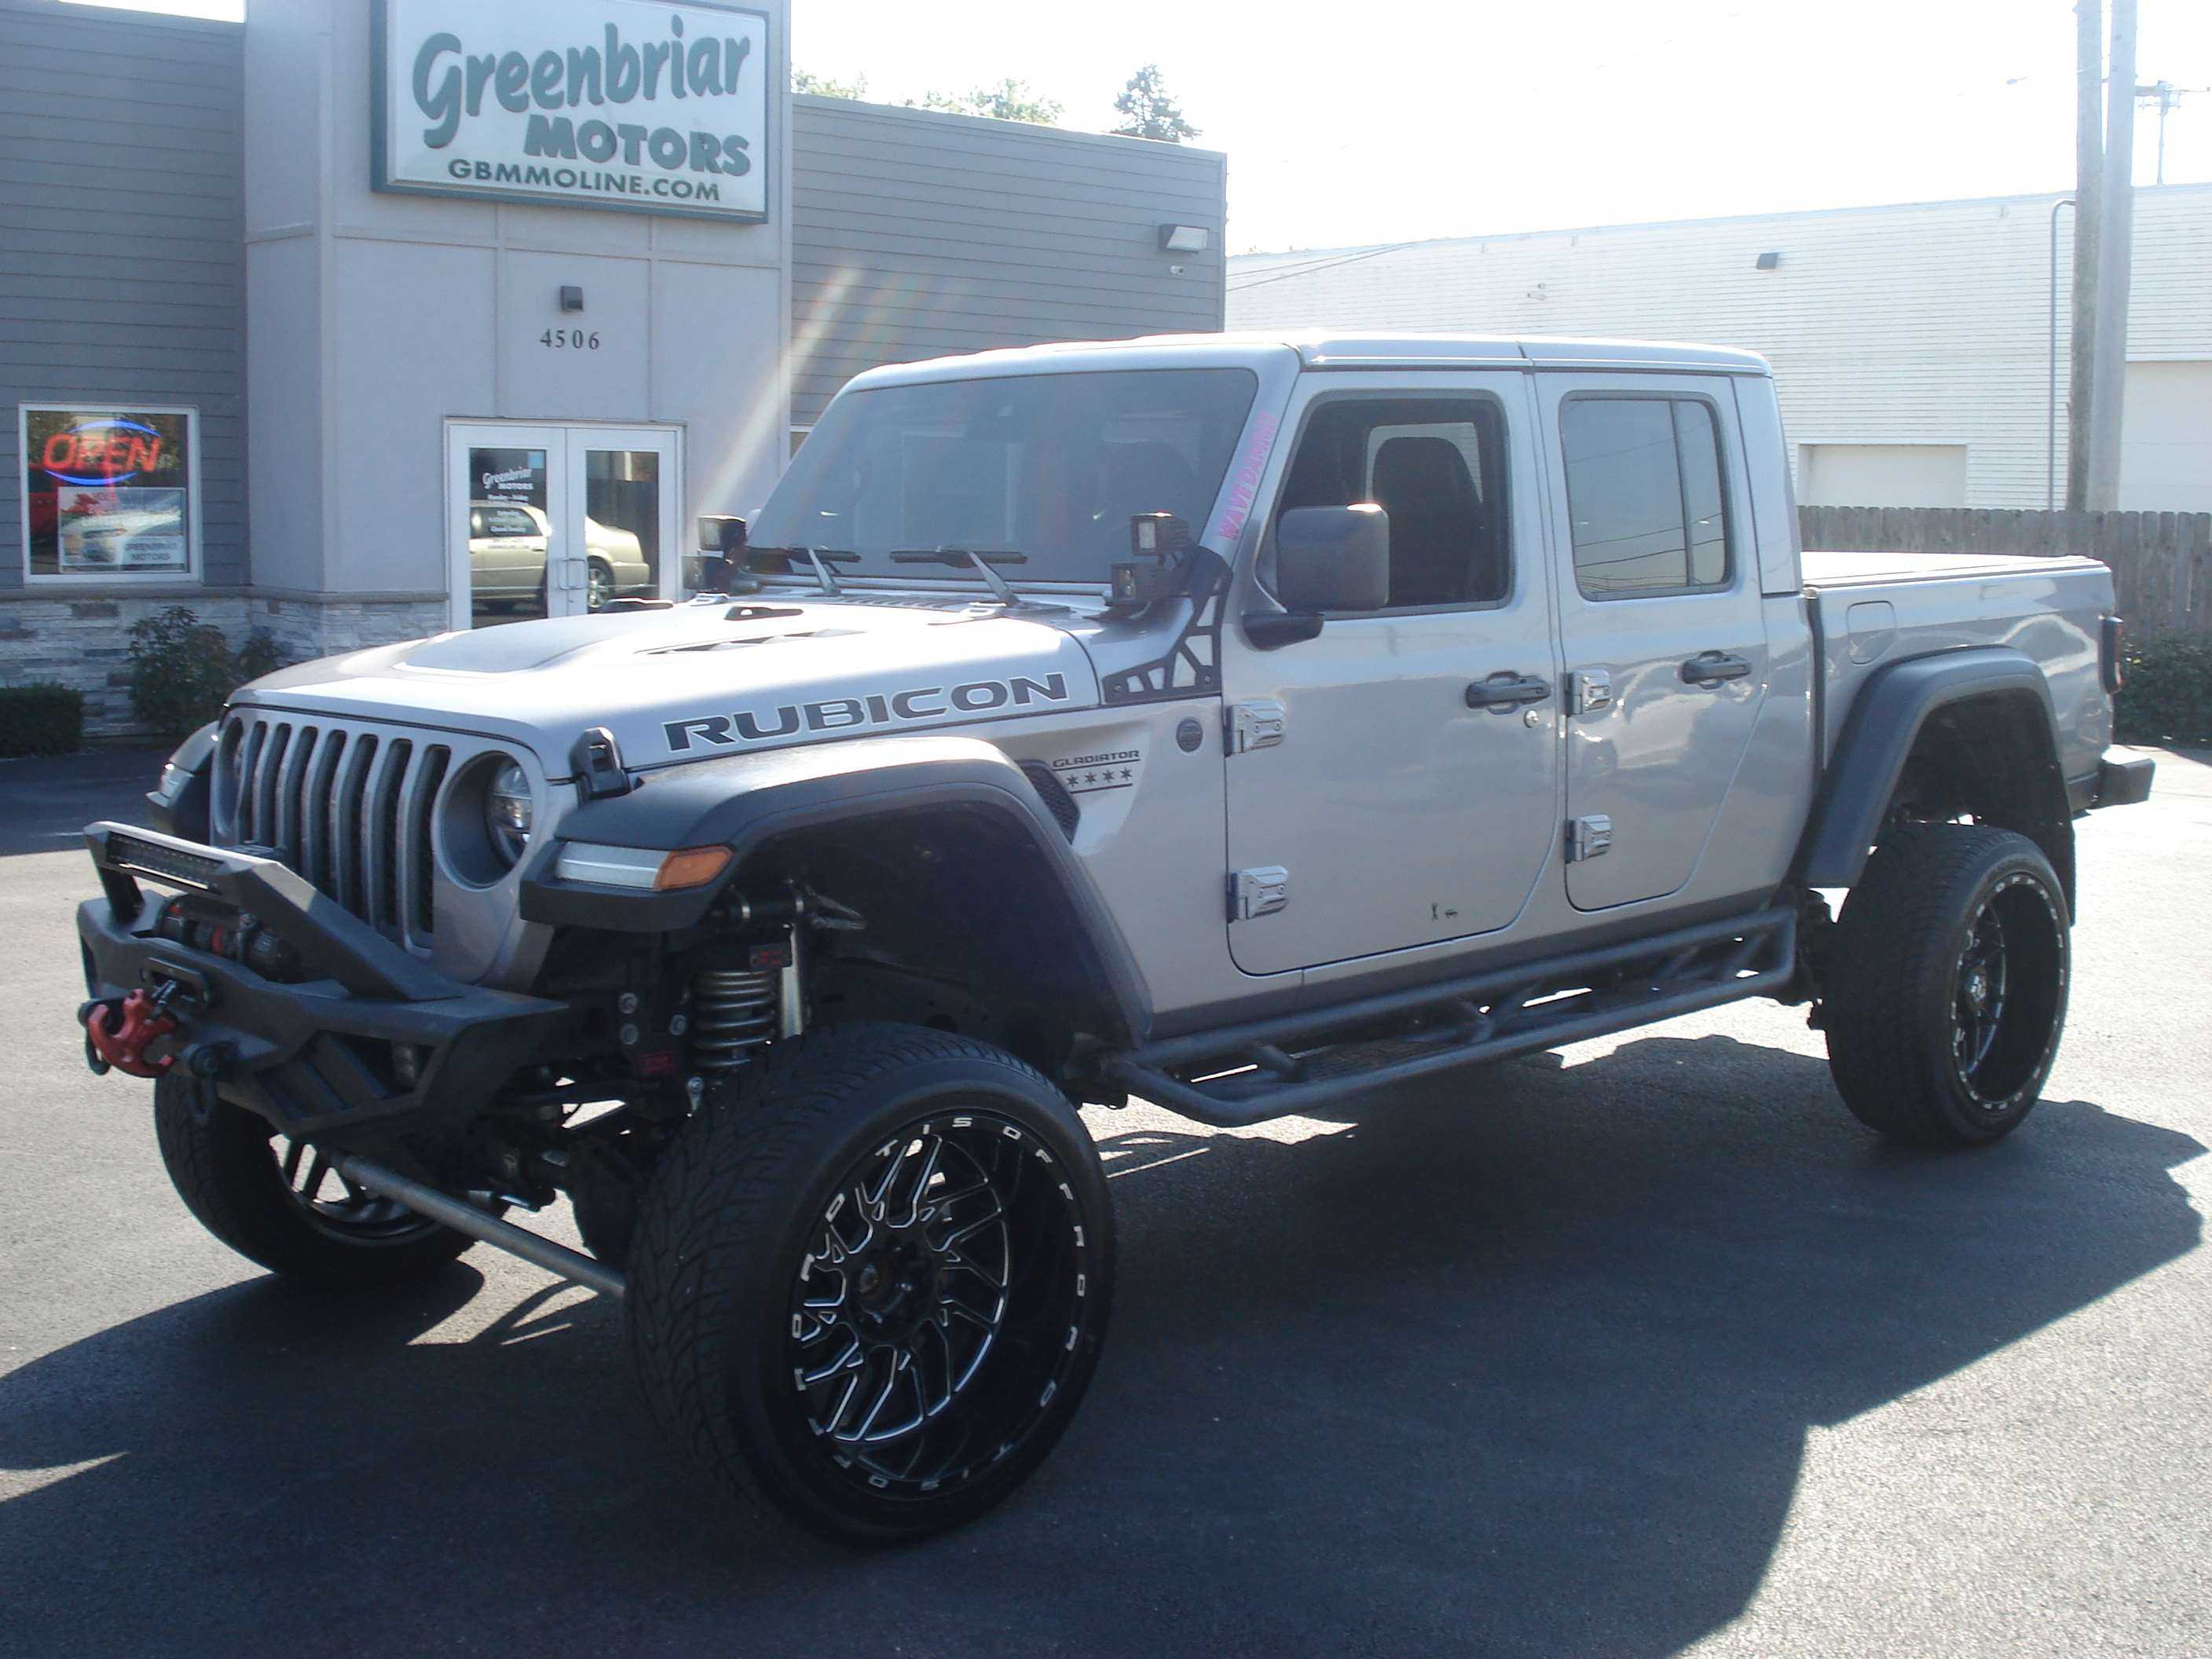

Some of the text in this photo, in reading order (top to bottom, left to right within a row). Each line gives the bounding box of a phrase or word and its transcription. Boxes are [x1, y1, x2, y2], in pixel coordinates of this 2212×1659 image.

[412, 13, 751, 149] Greenbriar
[523, 114, 751, 177] MOTORS
[448, 158, 720, 202] GBMMOLINE.COM
[540, 328, 599, 350] 4506
[42, 433, 161, 472] OPEN
[662, 672, 1070, 753] RUBICON
[1053, 749, 1140, 767] GLADIATOR
